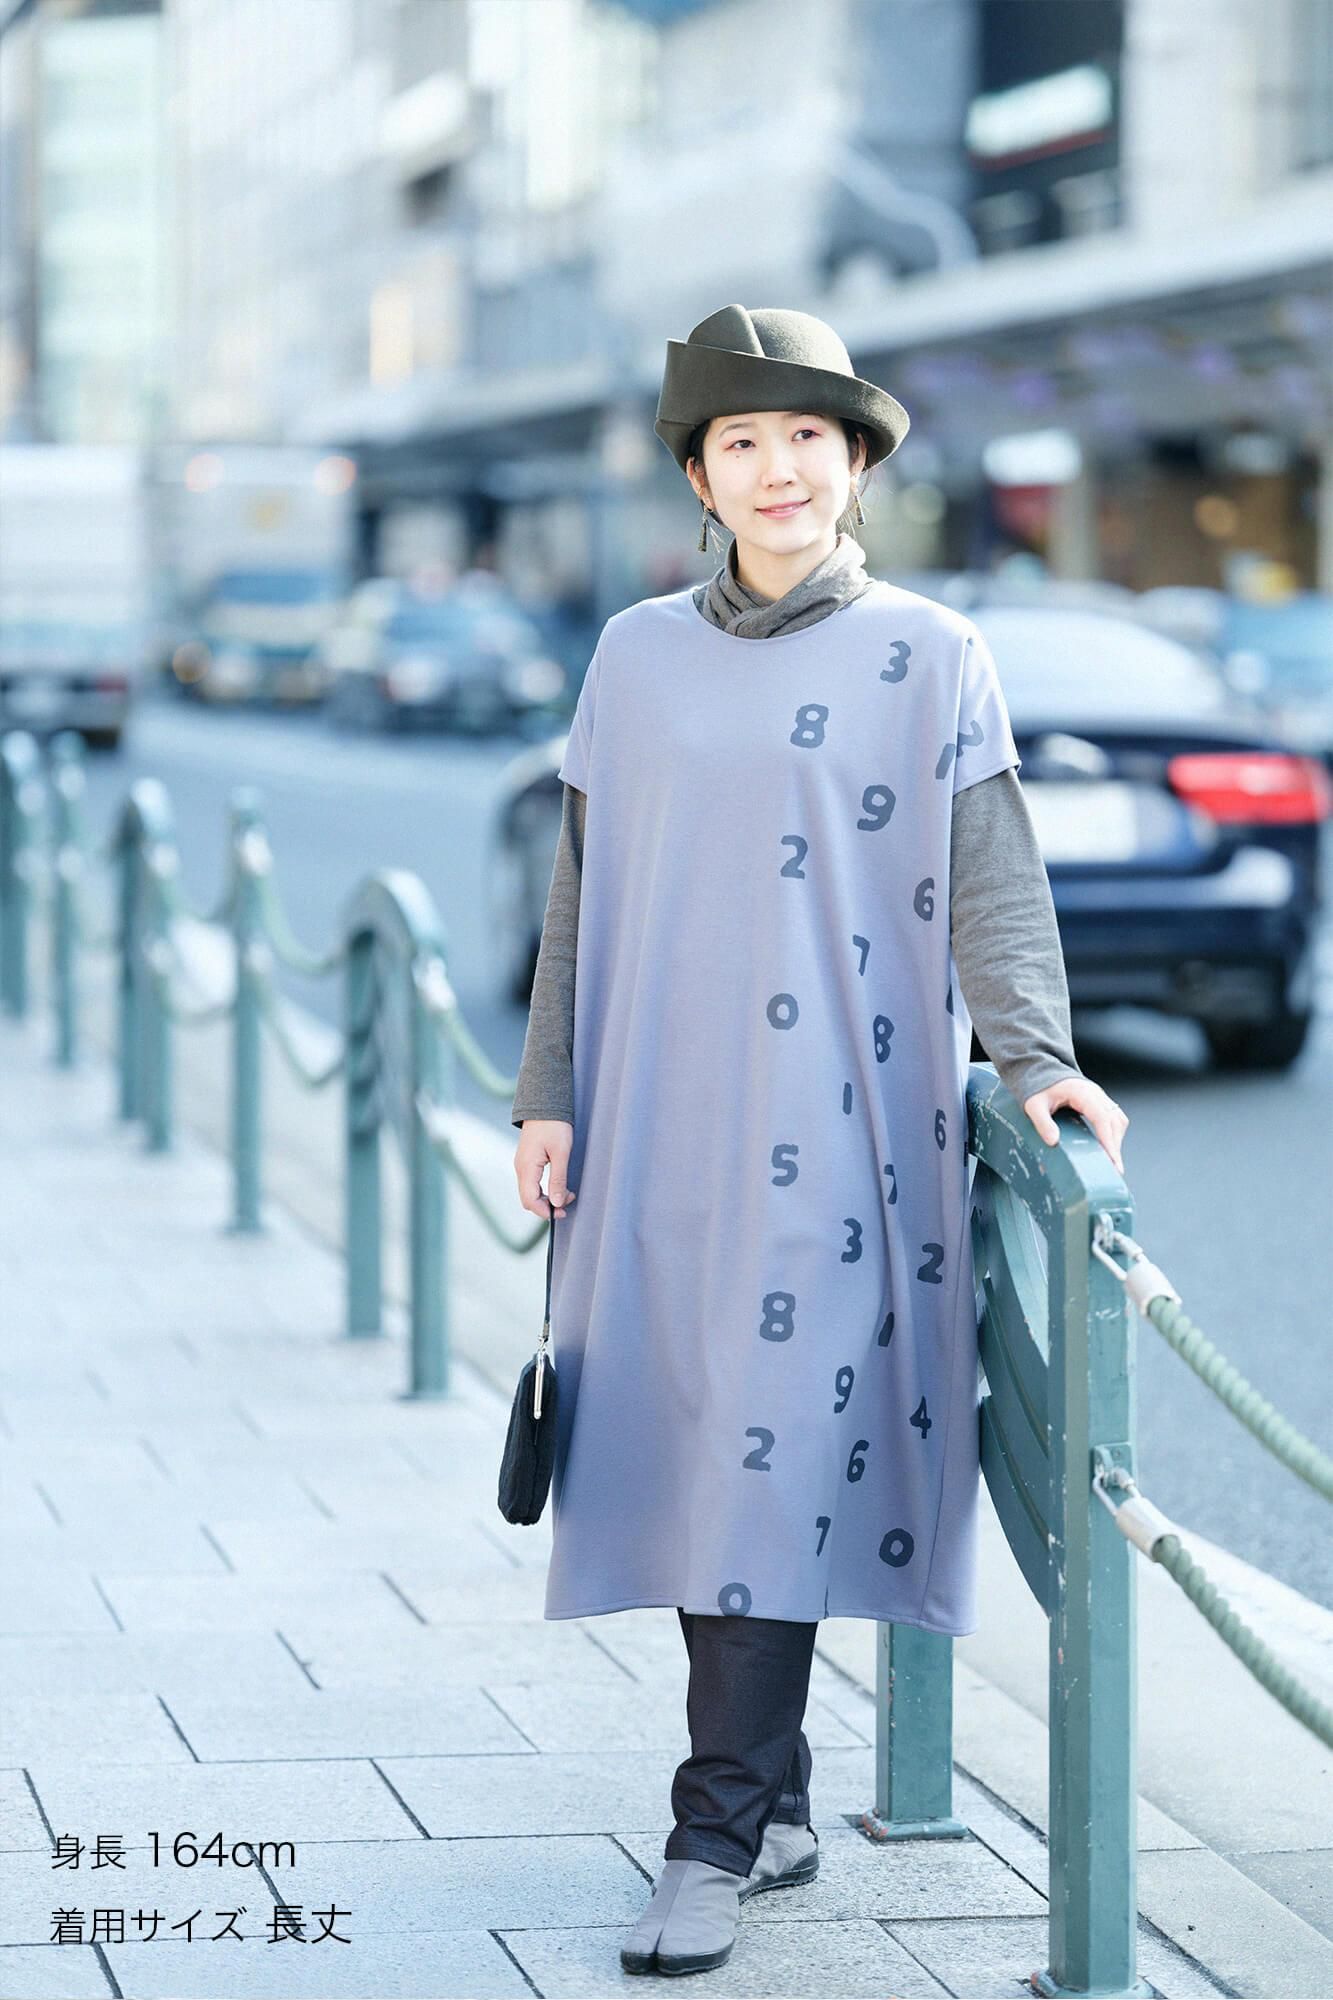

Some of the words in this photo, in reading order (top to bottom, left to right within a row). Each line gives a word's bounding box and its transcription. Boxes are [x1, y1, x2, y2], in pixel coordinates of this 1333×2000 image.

[880, 641, 911, 683] 3
[790, 704, 829, 748] 8
[857, 785, 896, 832] 9
[780, 835, 808, 879] 2
[913, 878, 935, 921] 6
[853, 935, 870, 976] 7
[873, 1015, 895, 1063] 8
[935, 1109, 946, 1151] 6
[772, 1144, 799, 1187] 5
[841, 1218, 862, 1263] 3
[917, 1243, 944, 1284] 2
[760, 1291, 796, 1342] 8
[834, 1366, 854, 1413] 9
[910, 1396, 932, 1439] 4
[743, 1427, 775, 1472] 2
[847, 1440, 870, 1483] 6
